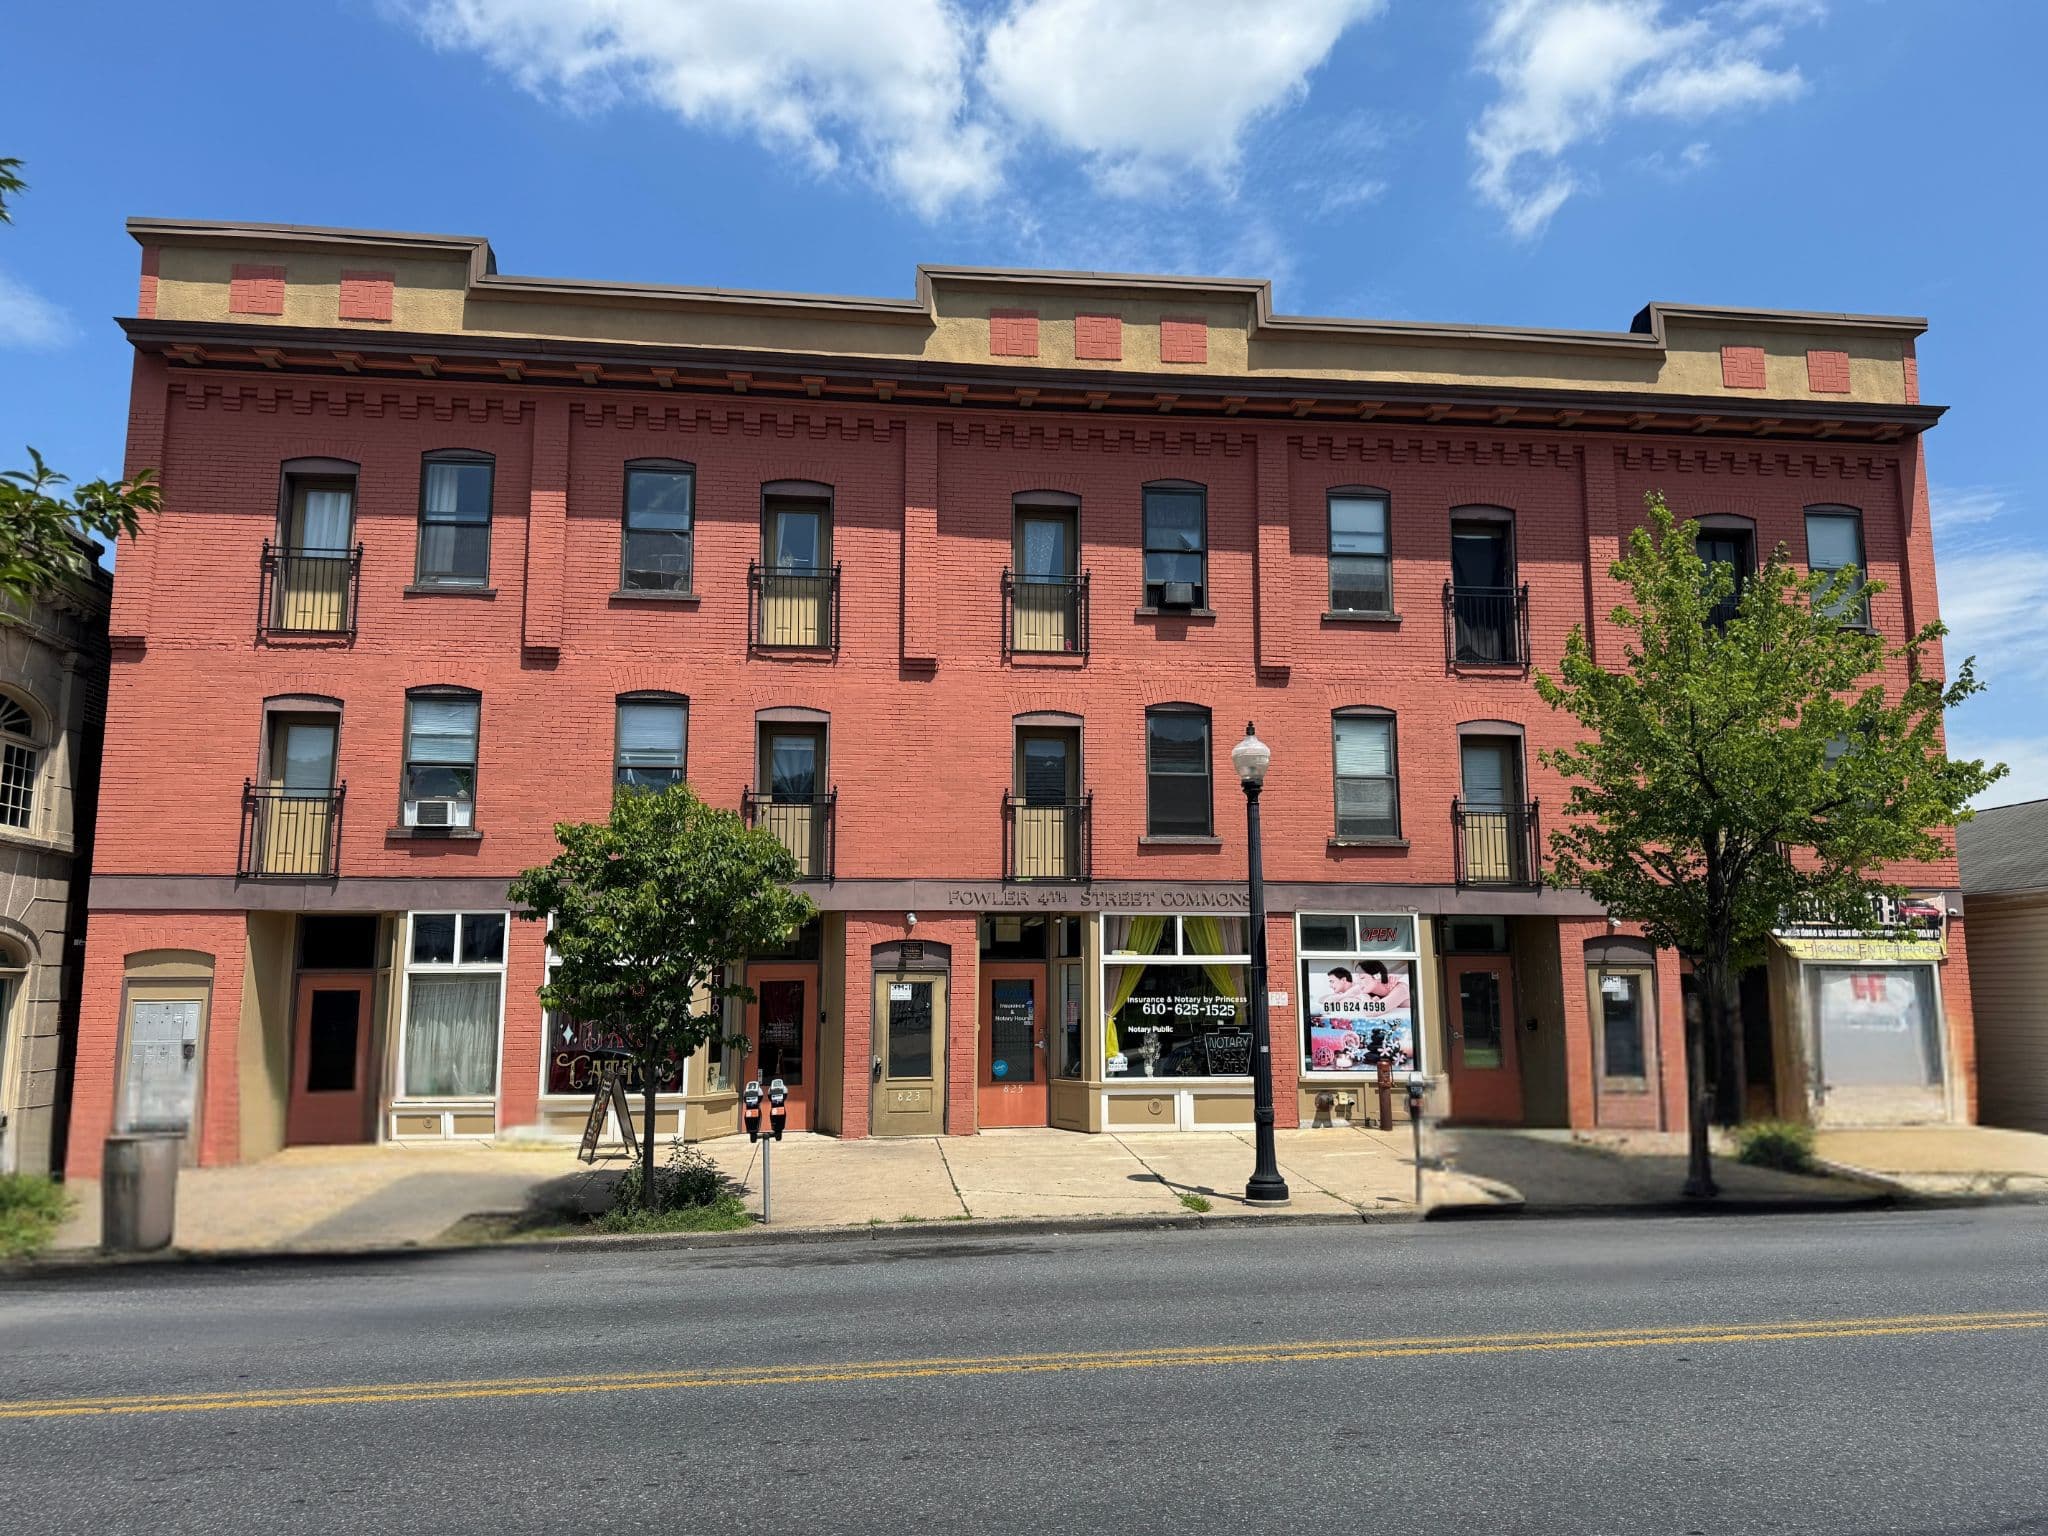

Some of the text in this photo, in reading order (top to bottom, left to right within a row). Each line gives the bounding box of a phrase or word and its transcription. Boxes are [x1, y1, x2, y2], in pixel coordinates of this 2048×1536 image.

[949, 890, 1251, 907] FOWLER 4TH STREET COMMONS
[1360, 927, 1397, 942] OPEN
[1174, 996, 1201, 1004] Notary
[1203, 995, 1213, 1004] by
[1215, 995, 1247, 1004] Princess
[1142, 1003, 1236, 1017] 610-625-1525
[1323, 1001, 1386, 1012] 610 624 4598
[1128, 1025, 1174, 1034] Notary Public
[1209, 1036, 1249, 1049] NOTARY
[897, 1089, 921, 1101] 823
